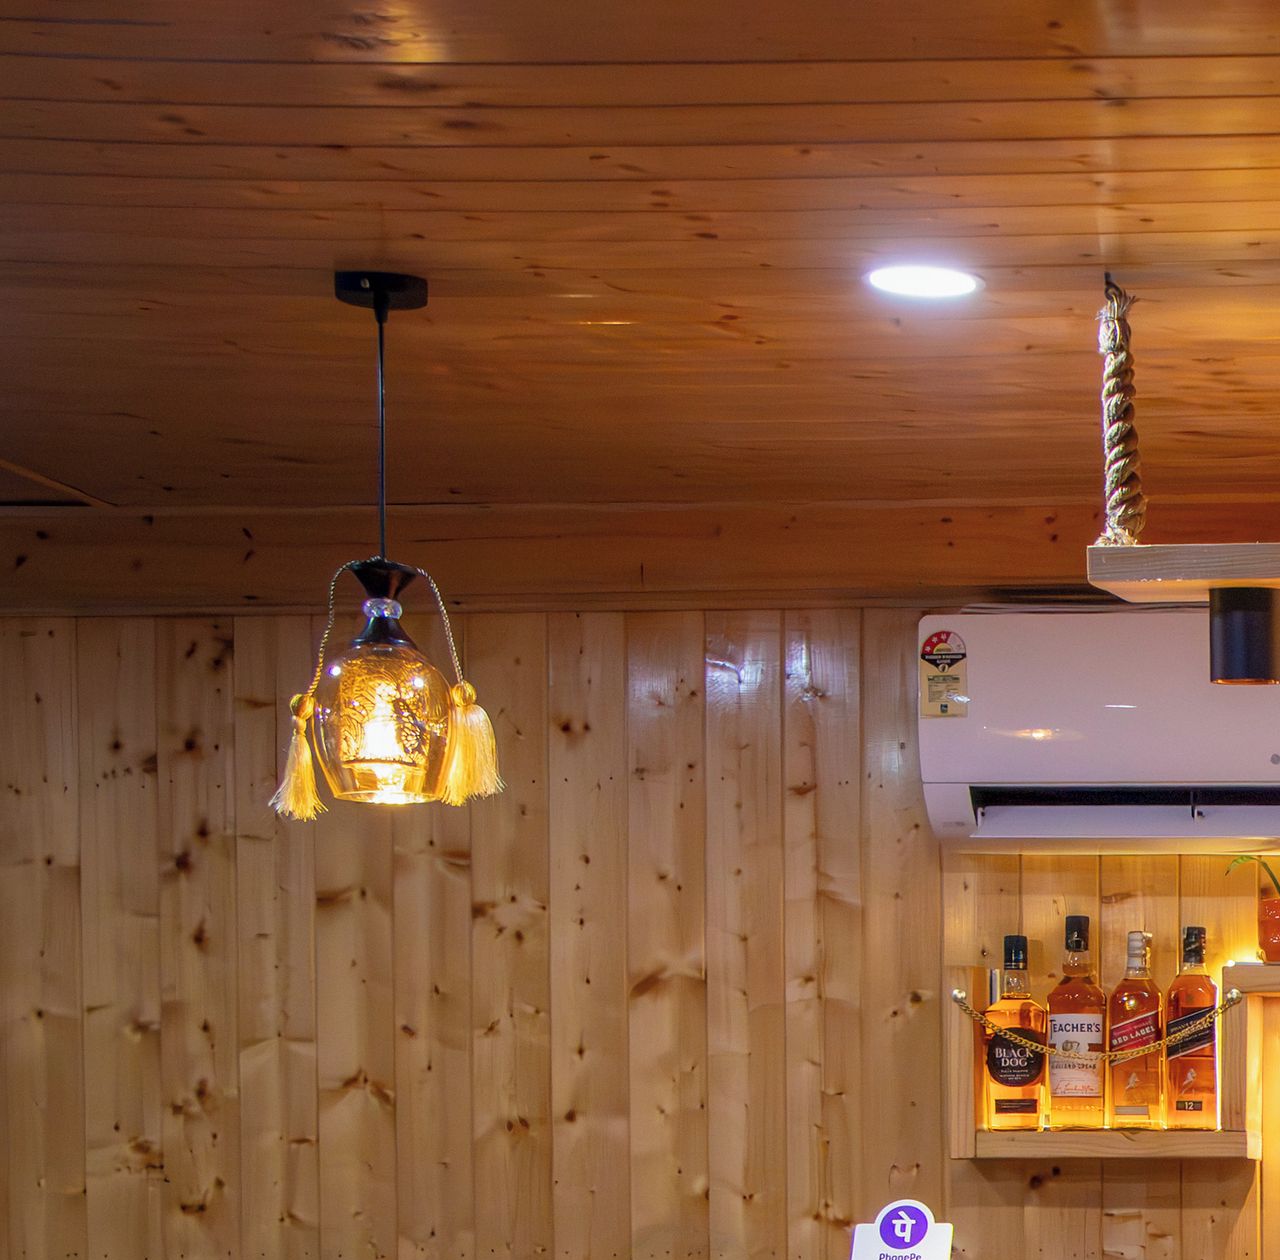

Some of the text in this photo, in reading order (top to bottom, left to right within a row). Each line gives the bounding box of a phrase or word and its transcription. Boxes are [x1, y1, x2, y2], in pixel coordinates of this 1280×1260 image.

[1050, 1020, 1101, 1040] TEACHER'S
[1112, 1035, 1129, 1045] RED
[1130, 1025, 1156, 1038] LABEL
[995, 1047, 1034, 1058] BLACK
[1001, 1058, 1028, 1067] DOG
[1184, 1101, 1194, 1110] 12
